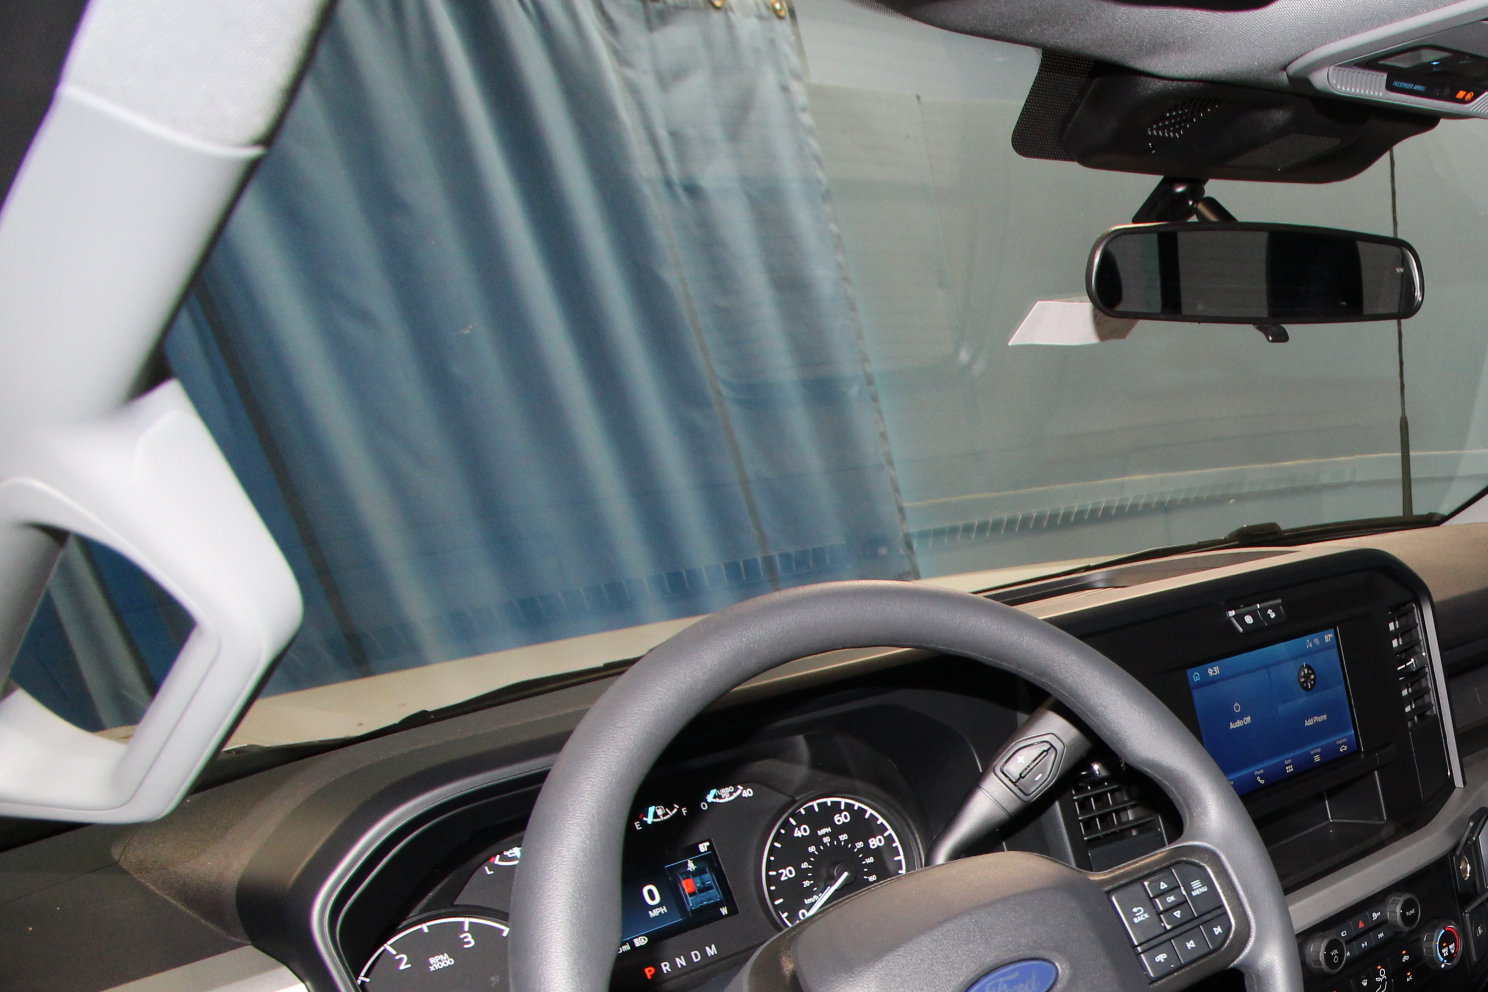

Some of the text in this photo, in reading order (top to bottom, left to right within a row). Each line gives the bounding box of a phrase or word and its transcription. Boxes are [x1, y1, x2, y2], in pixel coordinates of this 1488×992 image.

[1208, 666, 1220, 677] 9:31
[1230, 719, 1244, 730] Audio
[1313, 714, 1328, 723] Phone
[742, 788, 754, 798] 40
[681, 807, 688, 816] F
[833, 811, 850, 825] 60
[634, 821, 643, 831] E
[793, 824, 810, 838] 40
[817, 826, 832, 836] MPH
[838, 833, 848, 841] 100
[868, 835, 885, 849] 80
[484, 866, 494, 875] L
[778, 866, 796, 881] 20
[802, 880, 810, 888] 20
[641, 884, 661, 906] 0
[1191, 885, 1208, 897] MENU
[1166, 895, 1176, 903] OK
[649, 905, 668, 919] MPH
[720, 906, 728, 916] W
[798, 909, 808, 921] 0
[1133, 912, 1150, 924] BACK
[459, 932, 475, 948] 3
[394, 954, 412, 970] 2
[428, 953, 450, 965] RPM
[429, 958, 455, 972] x1000
[644, 944, 718, 980] P R N D M
